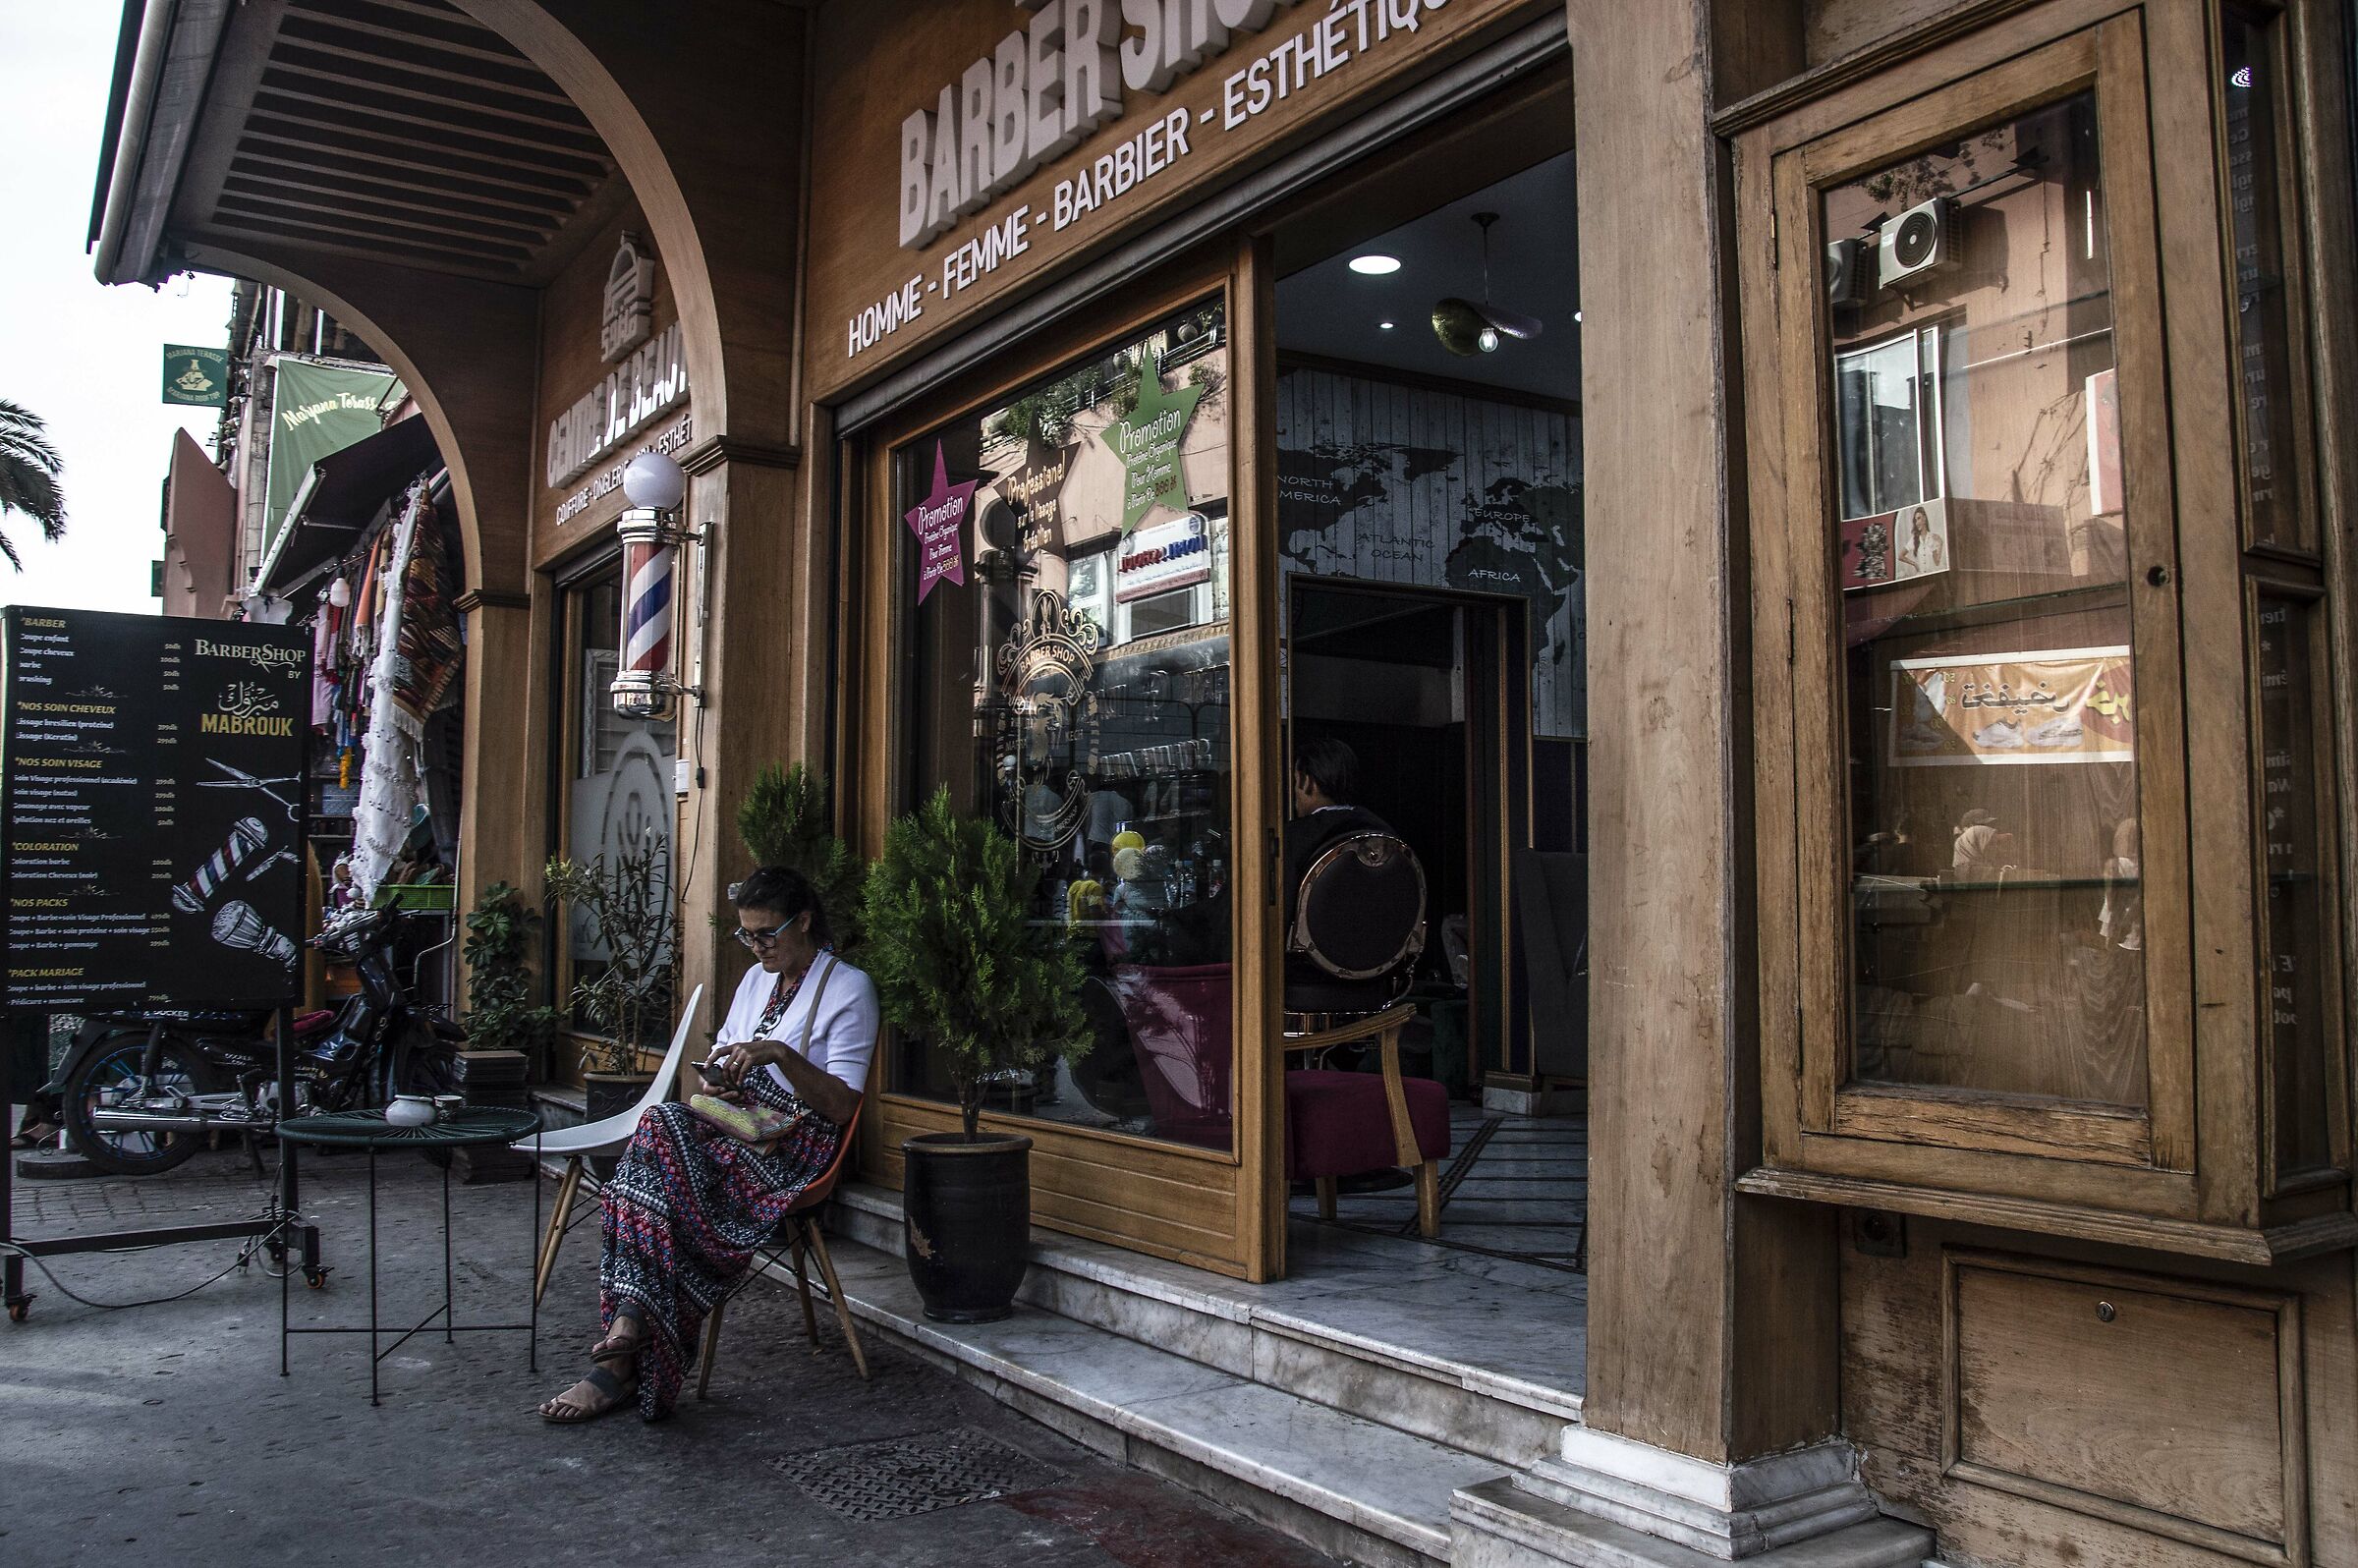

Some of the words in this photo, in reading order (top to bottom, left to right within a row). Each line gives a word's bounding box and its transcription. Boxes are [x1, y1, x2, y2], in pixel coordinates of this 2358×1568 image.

[899, 0, 1123, 251] BARBER
[847, 274, 924, 359] HOMME
[942, 203, 1032, 301] FEMME
[1053, 107, 1191, 233] BARBIER
[1224, 0, 1448, 132] ESTHÉTIQ
[281, 400, 338, 431] Maryana
[1119, 409, 1181, 454] Promotion
[556, 486, 590, 527] COIFFURE
[1278, 490, 1343, 506] MERICA
[918, 495, 963, 535] Promotion
[1474, 507, 1531, 524] EUROPE
[1356, 532, 1435, 549] ATLANTIC
[1371, 548, 1425, 563] OCEAN
[1468, 568, 1521, 583] AFRICA
[1020, 644, 1051, 673] BARBER
[1052, 644, 1075, 664] SHOP
[288, 670, 302, 679] BY
[45, 702, 69, 711] SOIN
[70, 704, 116, 714] CHEVEUX
[200, 713, 294, 737] MABROUK
[42, 758, 67, 767] SOIN
[68, 759, 103, 768] VISAGE
[35, 898, 69, 907] PACKS
[39, 968, 84, 978] MARIAGE
